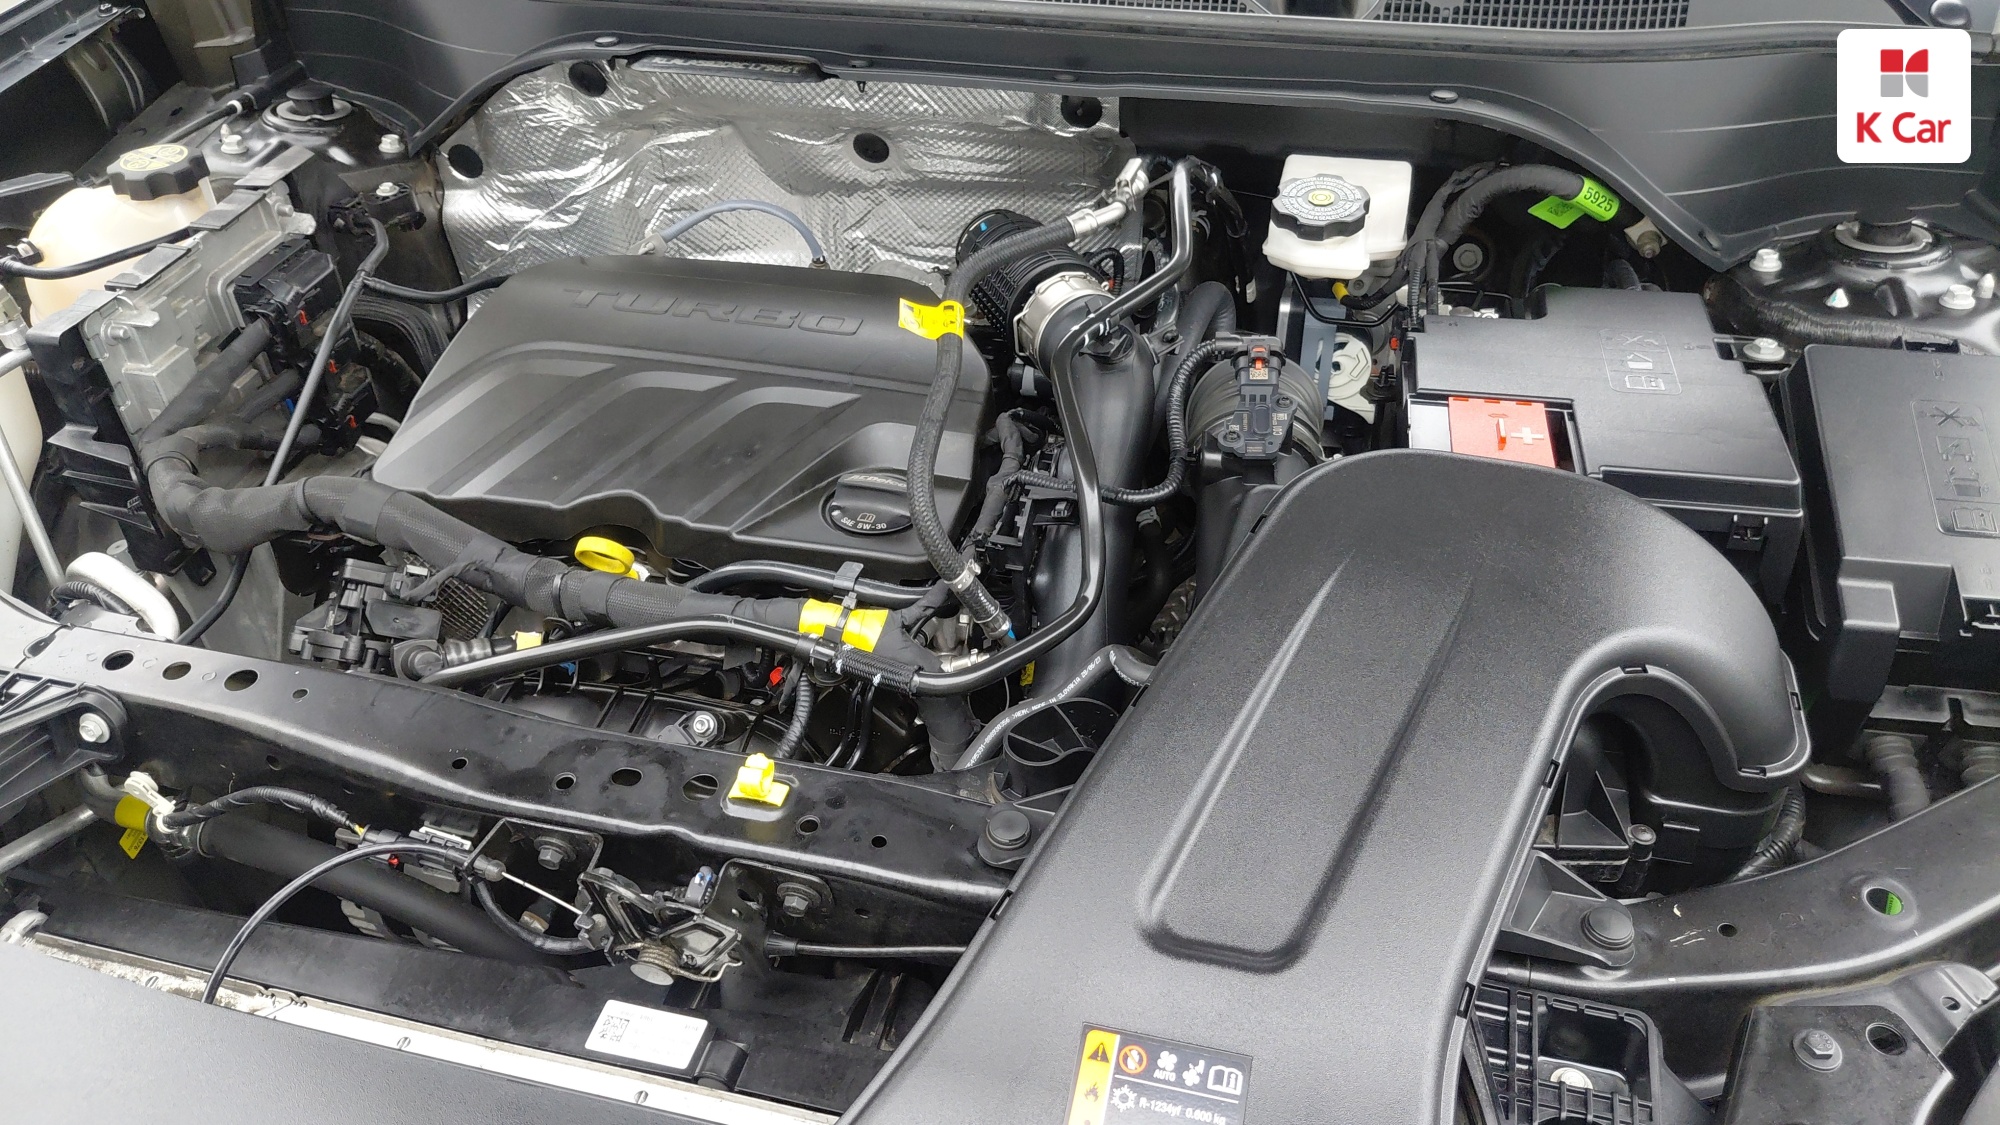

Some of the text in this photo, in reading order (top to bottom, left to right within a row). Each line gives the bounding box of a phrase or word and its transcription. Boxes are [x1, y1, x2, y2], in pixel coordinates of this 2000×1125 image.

[1583, 187, 1613, 212] 5925
[563, 288, 864, 336] TURBO
[841, 517, 887, 530] SAE 5W-30
[1153, 1069, 1176, 1082] AUTO
[1138, 1097, 1182, 1118] R-1234yf
